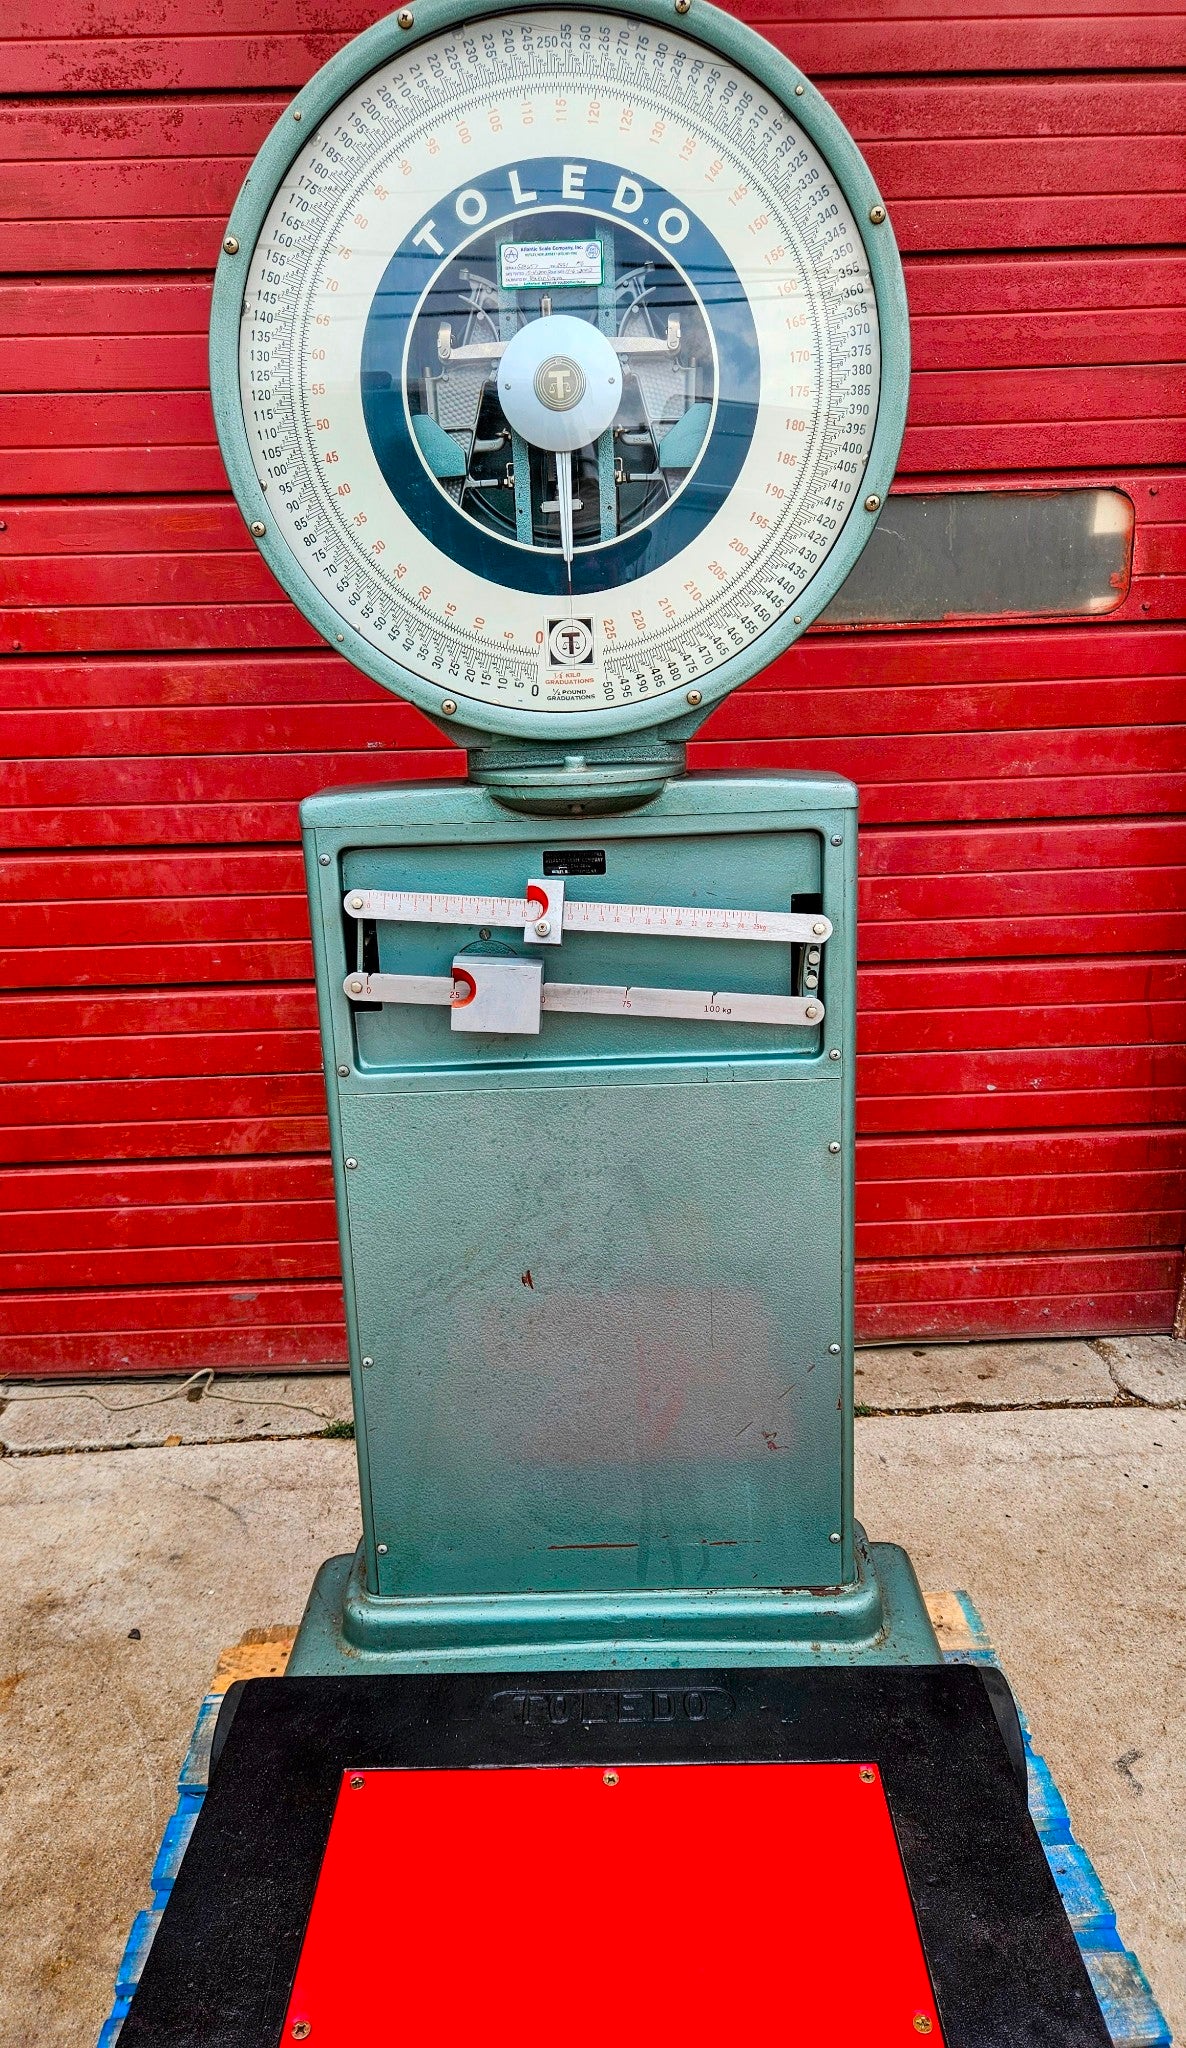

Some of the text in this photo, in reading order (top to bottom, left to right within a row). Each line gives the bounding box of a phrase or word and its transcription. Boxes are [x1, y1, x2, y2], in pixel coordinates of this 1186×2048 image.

[502, 29, 515, 53] 240
[522, 26, 534, 50] 245
[537, 36, 558, 49] 250
[580, 25, 591, 49] 260
[598, 27, 610, 52] 265
[617, 31, 630, 55] 270
[446, 45, 461, 70] 225
[464, 38, 479, 63] 230
[653, 42, 668, 67] 280
[428, 53, 444, 78] 220
[670, 50, 686, 74] 285
[394, 73, 411, 97] 210
[720, 80, 737, 104] 300
[378, 85, 395, 108] 205
[735, 93, 753, 116] 305
[362, 98, 381, 121] 200
[521, 101, 533, 125] 110
[555, 99, 566, 122] 115
[587, 101, 600, 125] 120
[749, 106, 768, 129] 310
[487, 108, 502, 133] 105
[619, 108, 633, 133] 125
[334, 126, 353, 148] 190
[455, 120, 472, 145] 100
[649, 121, 666, 145] 130
[321, 142, 341, 163] 185
[425, 138, 439, 154] 95
[678, 138, 696, 162] 135
[776, 136, 795, 157] 320
[310, 158, 329, 179] 180
[398, 159, 413, 176] 90
[788, 152, 808, 173] 325
[704, 160, 723, 183] 140
[799, 169, 819, 189] 330
[374, 184, 389, 201] 85
[727, 185, 747, 207] 145
[289, 193, 309, 212] 170
[412, 164, 690, 255] TOLEDO
[280, 211, 301, 230] 165
[353, 213, 368, 229] 80
[818, 205, 838, 224] 340
[747, 214, 768, 235] 150
[826, 224, 847, 242] 345
[273, 230, 293, 248] 160
[337, 244, 351, 259] 75
[764, 246, 785, 265] 155
[833, 243, 854, 260] 350
[261, 269, 281, 285] 150
[324, 278, 338, 292] 70
[777, 279, 798, 296] 160
[844, 283, 864, 298] 360
[257, 289, 277, 304] 145
[254, 310, 274, 324] 140
[847, 303, 868, 318] 365
[316, 313, 330, 326] 65
[785, 314, 806, 330] 165
[850, 324, 870, 337] 370
[251, 350, 270, 362] 130
[312, 348, 325, 360] 60
[790, 350, 810, 363] 170
[251, 371, 270, 381] 125
[852, 365, 872, 376] 380
[252, 390, 271, 401] 120
[312, 384, 325, 395] 55
[790, 386, 809, 397] 175
[851, 385, 871, 395] 385
[849, 404, 869, 416] 390
[316, 418, 330, 430] 50
[785, 419, 805, 433] 180
[257, 428, 277, 441] 110
[262, 447, 281, 460] 105
[842, 442, 862, 455] 400
[324, 452, 338, 464] 45
[777, 452, 797, 467] 185
[267, 465, 287, 479] 100
[838, 460, 857, 474] 405
[337, 483, 350, 497] 40
[765, 482, 785, 499] 190
[832, 478, 851, 493] 410
[287, 500, 300, 513] 90
[295, 517, 308, 530] 85
[354, 512, 368, 527] 35
[749, 511, 769, 529] 195
[817, 513, 836, 529] 420
[304, 533, 317, 546] 80
[808, 530, 828, 546] 425
[372, 540, 385, 554] 30
[729, 538, 749, 556] 200
[799, 547, 818, 564] 430
[324, 564, 337, 577] 70
[394, 564, 407, 578] 25
[708, 561, 727, 580] 205
[335, 578, 348, 592] 65
[418, 585, 431, 599] 20
[684, 581, 702, 601] 210
[777, 576, 796, 594] 440
[347, 592, 360, 605] 60
[766, 590, 784, 608] 445
[444, 603, 456, 616] 15
[659, 597, 675, 618] 215
[753, 603, 771, 622] 450
[373, 617, 386, 630] 50
[473, 617, 485, 631] 10
[604, 619, 616, 639] 225
[632, 610, 646, 631] 220
[387, 627, 400, 641] 45
[536, 630, 543, 643] 0
[726, 626, 743, 646] 460
[402, 638, 414, 651] 40
[712, 637, 729, 656] 465
[432, 655, 444, 669] 30
[698, 646, 713, 666] 470
[448, 662, 459, 676] 25
[464, 669, 475, 682] 20
[652, 668, 665, 687] 485
[668, 661, 682, 681] 480
[497, 679, 507, 691] 10
[531, 684, 539, 696] 0
[603, 681, 614, 701] 500
[636, 673, 648, 693] 490
[366, 987, 372, 995] 0
[450, 991, 460, 999] 25
[703, 1005, 721, 1013] 100
[512, 1693, 707, 1724] TOLEDO
